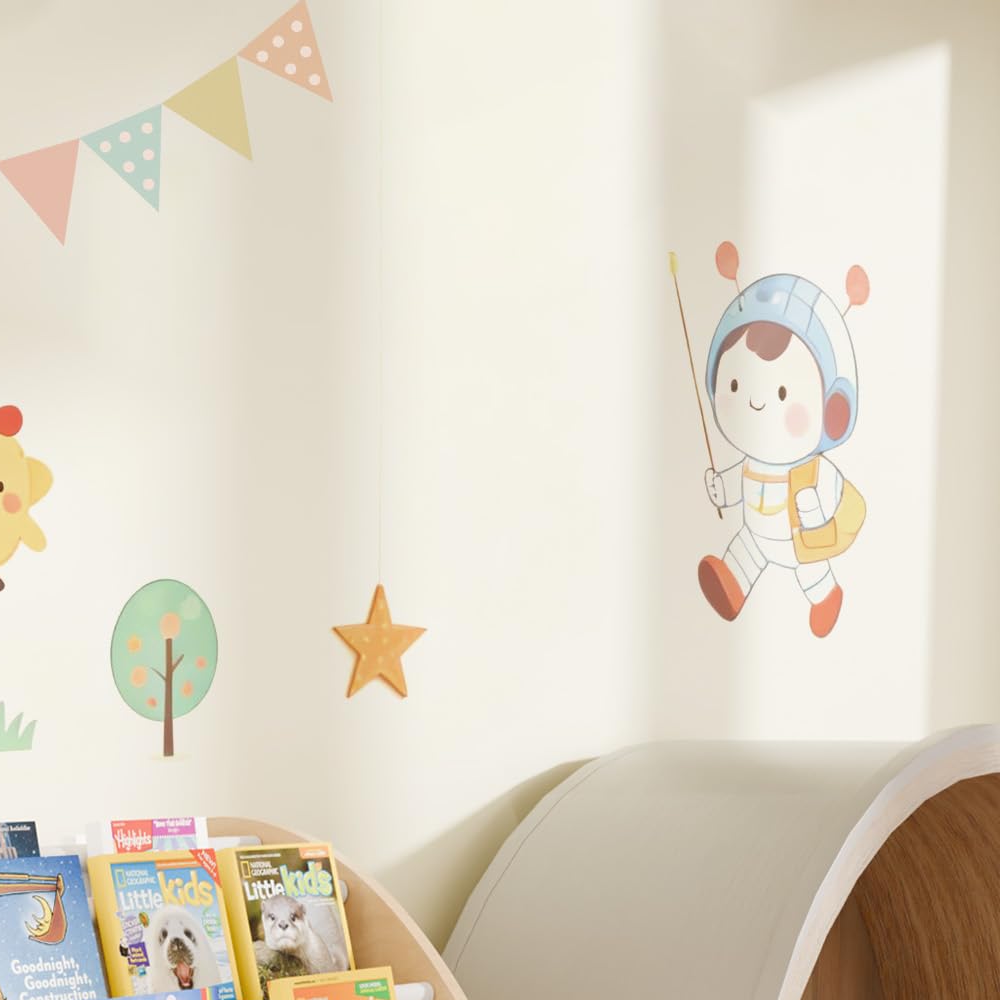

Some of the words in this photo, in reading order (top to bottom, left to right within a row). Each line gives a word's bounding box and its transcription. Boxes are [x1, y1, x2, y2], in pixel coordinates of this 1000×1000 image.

[115, 829, 152, 851] Highlights
[118, 888, 163, 911] Little
[156, 869, 214, 907] kids
[243, 879, 286, 901] Little
[279, 861, 334, 897] kids
[11, 955, 80, 975] Goodnight,
[24, 971, 93, 991] Goodnight,
